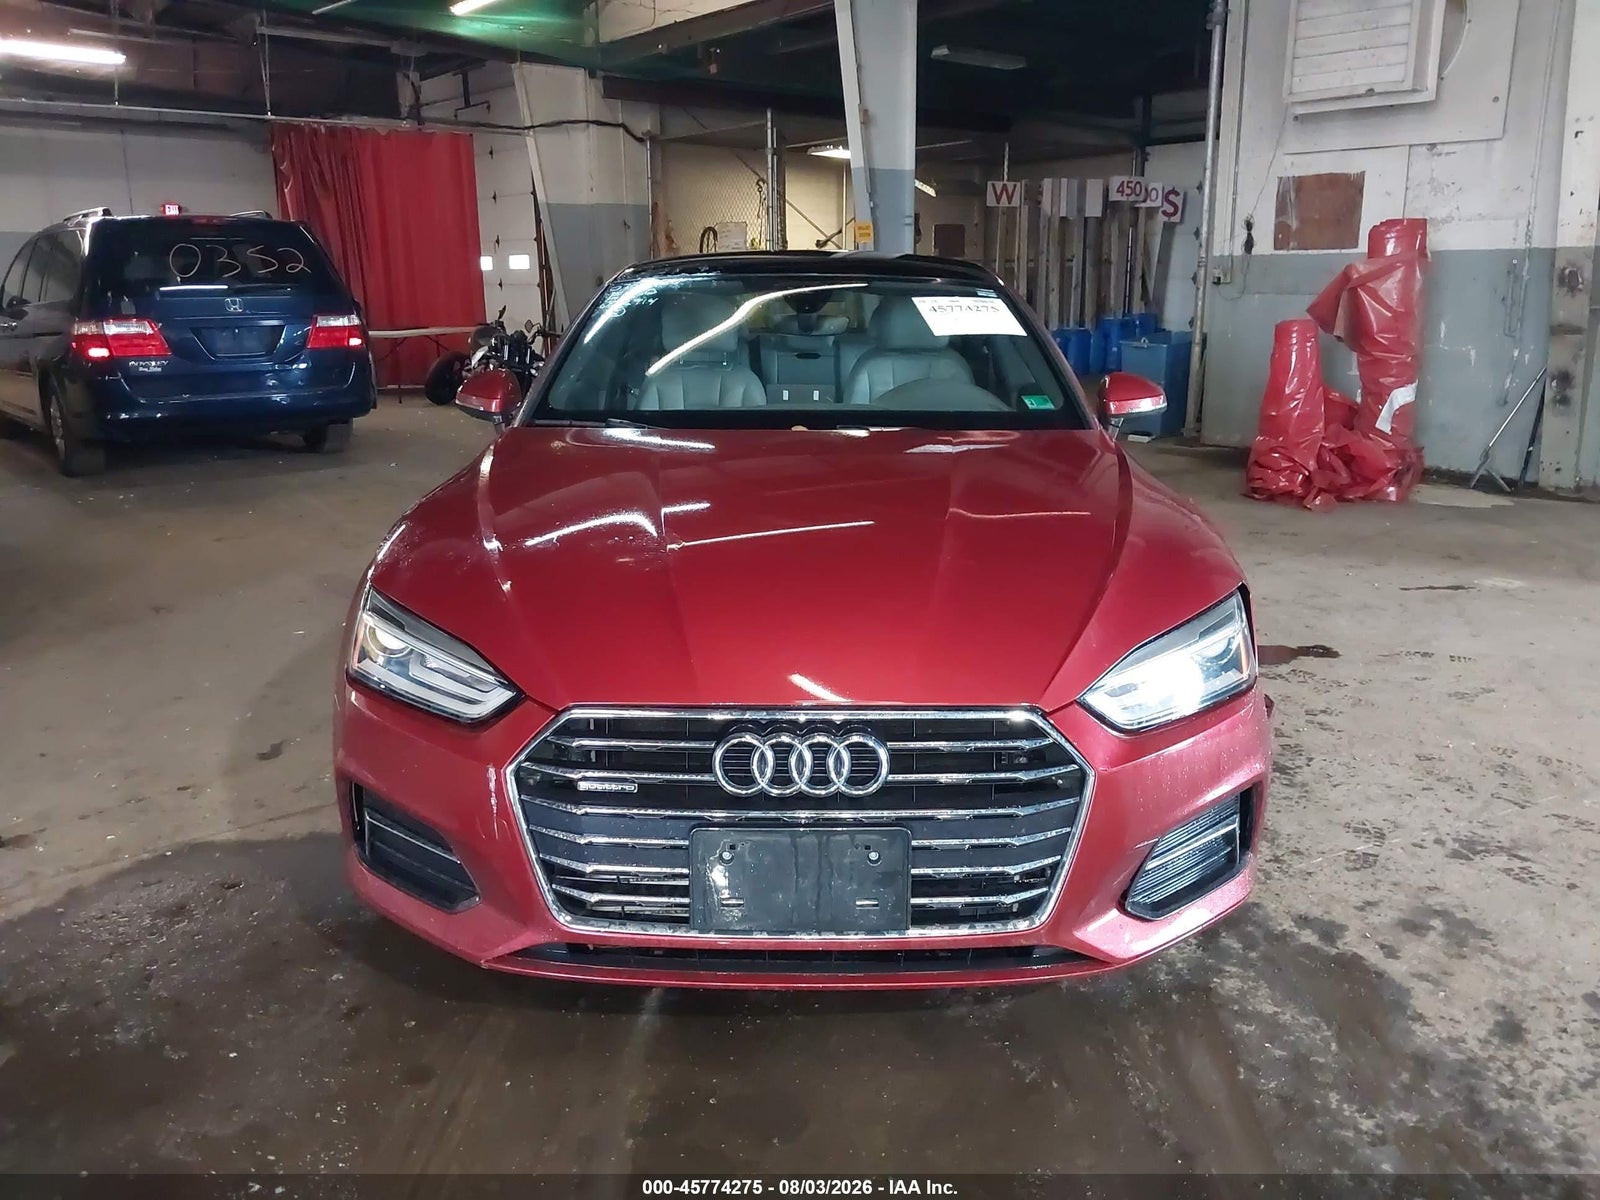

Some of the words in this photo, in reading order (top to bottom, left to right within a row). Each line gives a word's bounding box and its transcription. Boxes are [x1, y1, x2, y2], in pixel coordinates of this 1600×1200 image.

[991, 182, 1017, 205] W
[1115, 180, 1143, 198] 450
[169, 243, 312, 278] 0352
